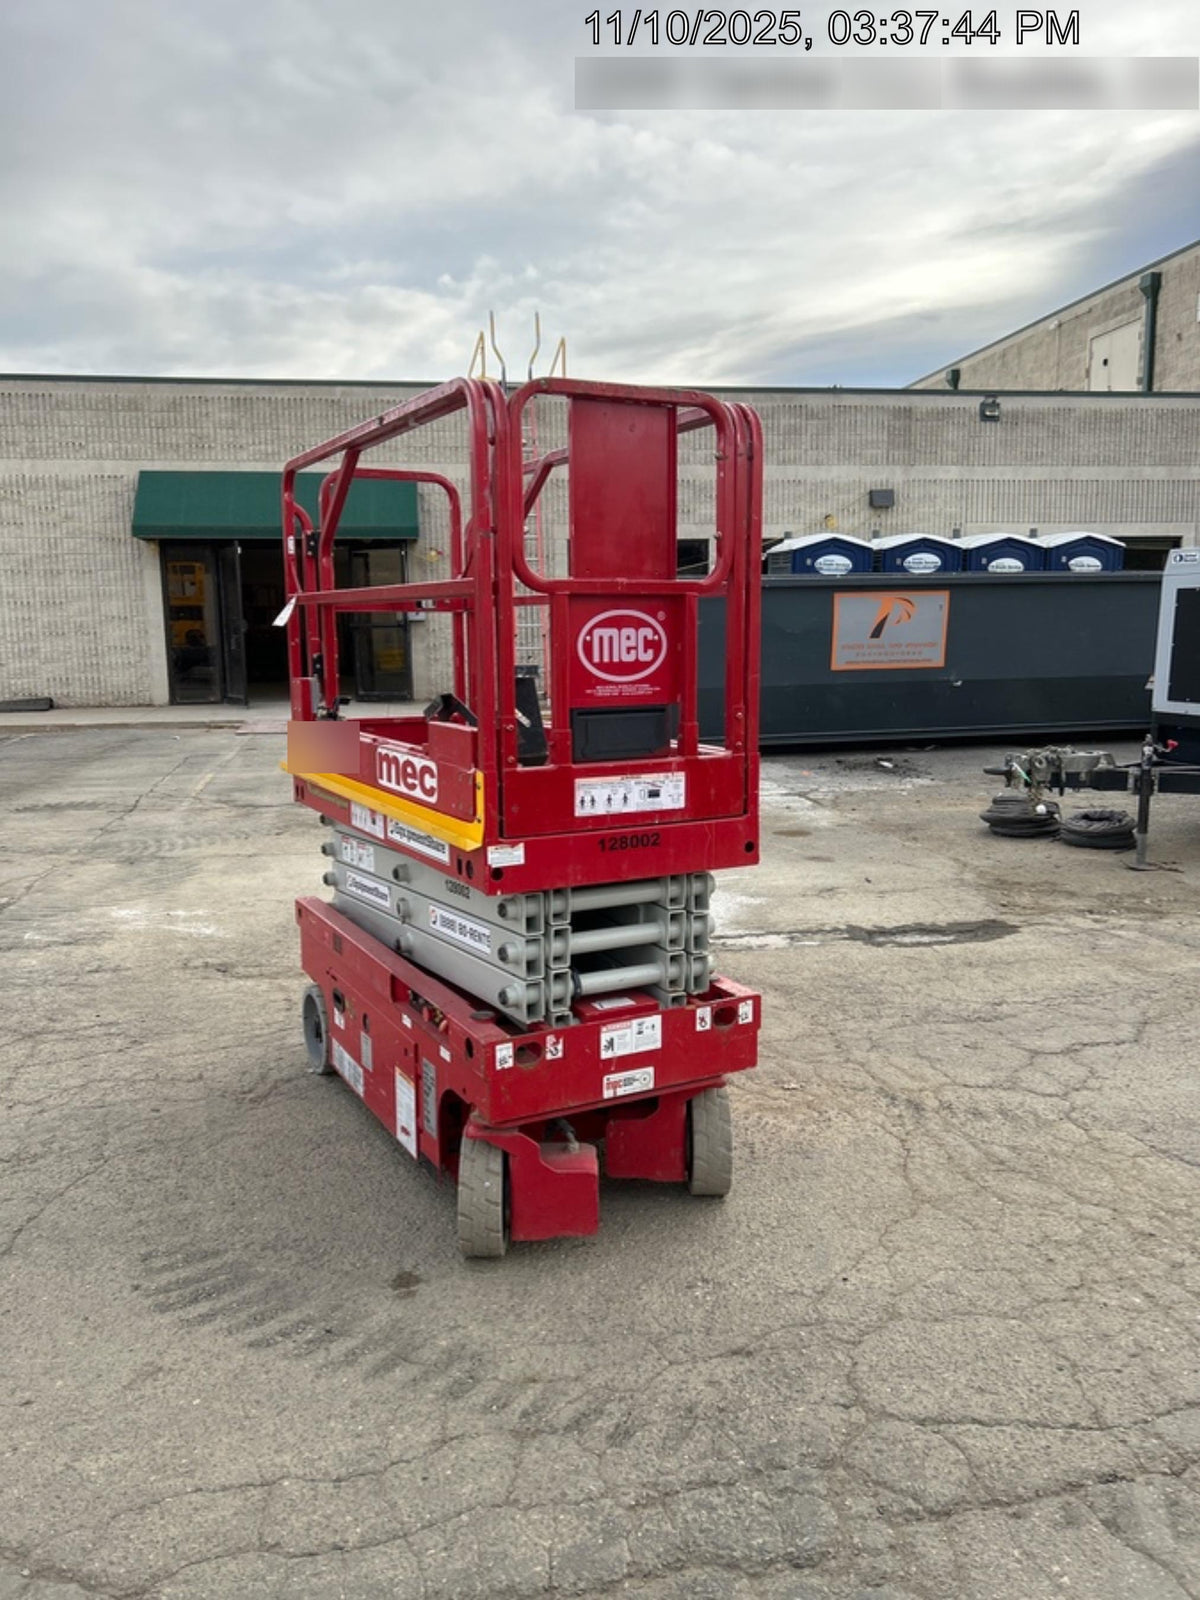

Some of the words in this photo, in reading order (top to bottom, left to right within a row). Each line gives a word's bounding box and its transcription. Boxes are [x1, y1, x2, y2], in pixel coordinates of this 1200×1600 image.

[592, 627, 655, 663] mec
[377, 750, 437, 798] mec
[598, 832, 661, 852] 128002
